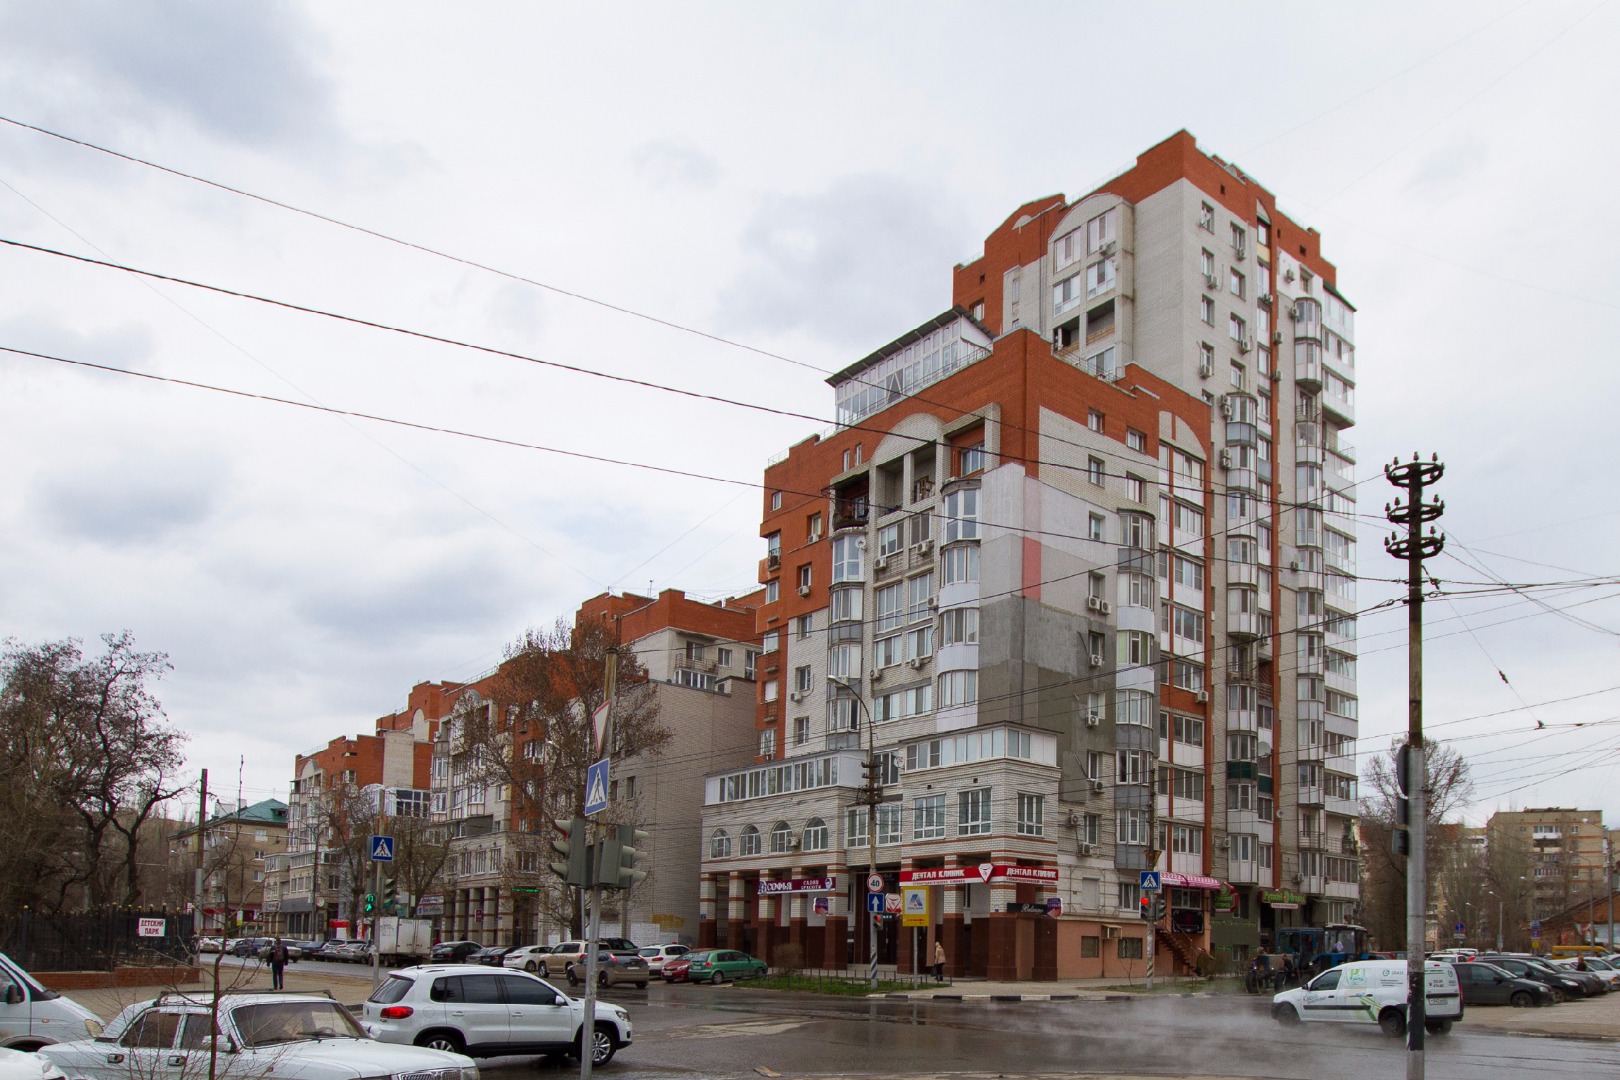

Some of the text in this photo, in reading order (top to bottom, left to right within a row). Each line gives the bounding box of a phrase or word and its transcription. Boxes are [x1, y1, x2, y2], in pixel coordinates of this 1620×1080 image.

[912, 869, 965, 880] ДЕНТАЛ КЛИНИК
[1006, 868, 1056, 878] ДЕНТАЛ КЛИНИК
[767, 881, 792, 891] СОФЬЯ
[870, 879, 880, 887] 40
